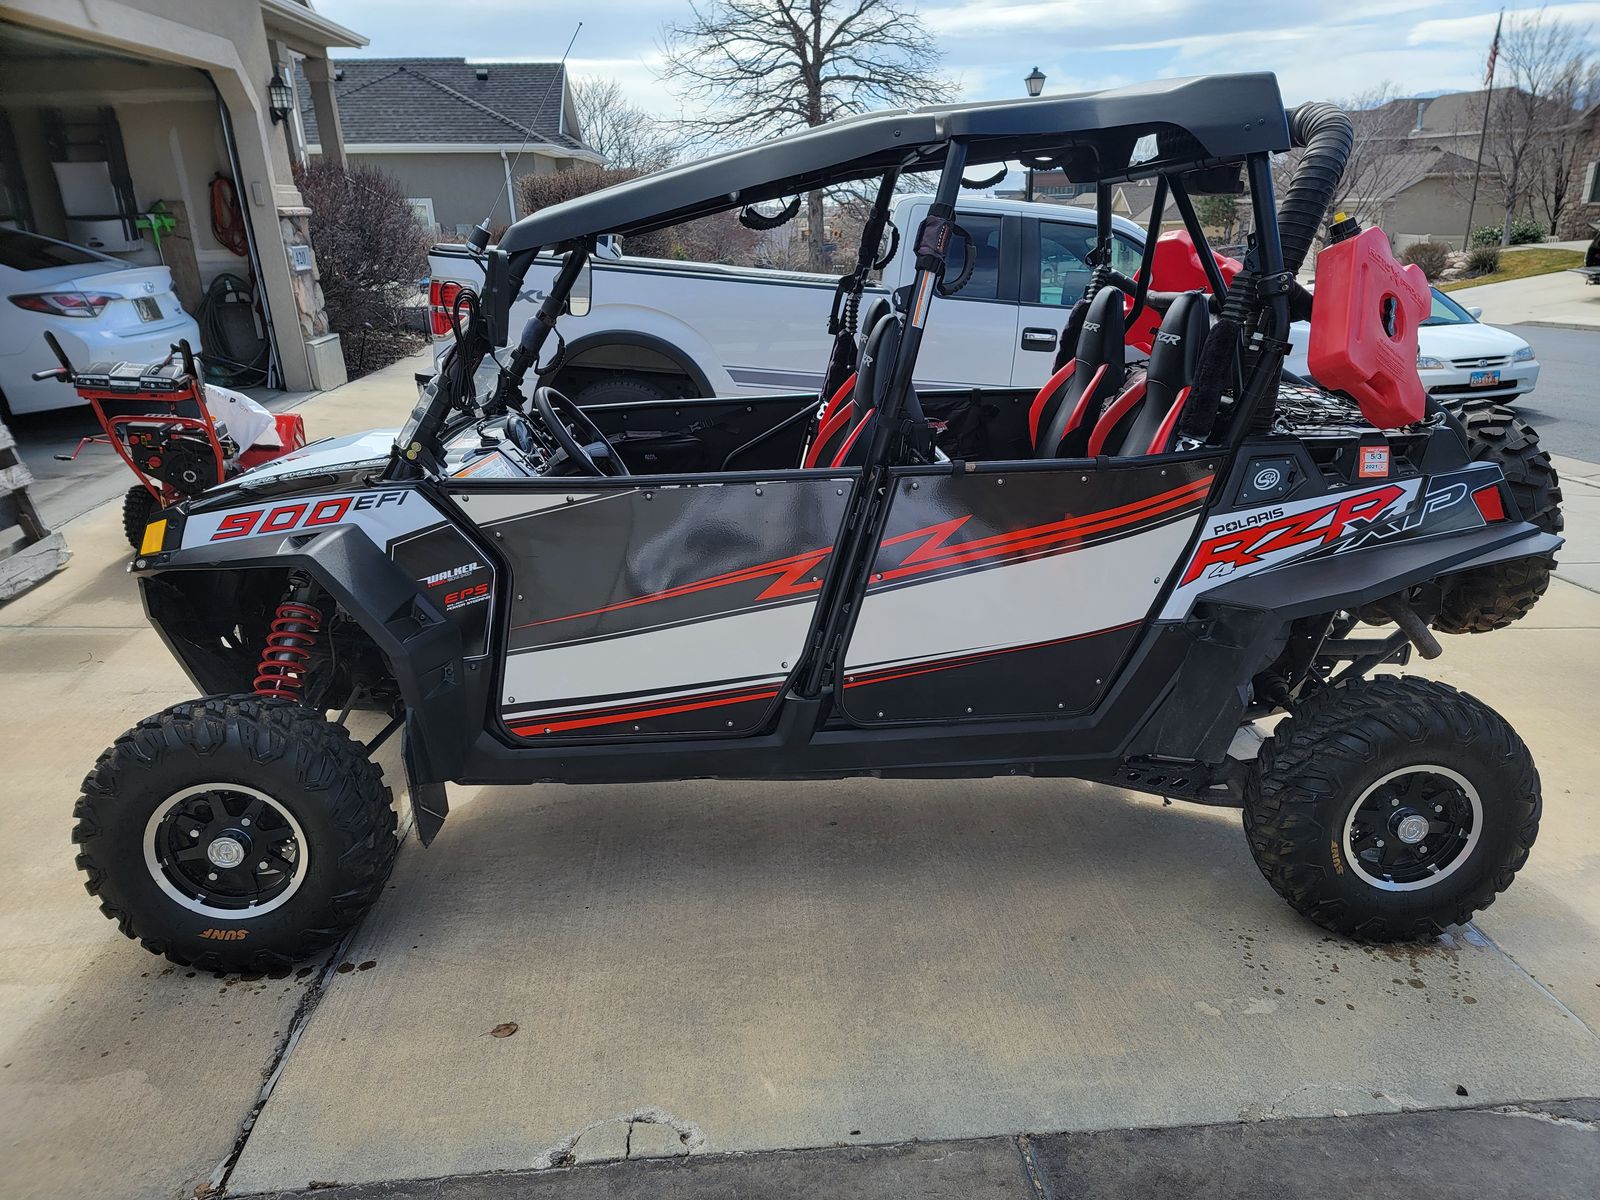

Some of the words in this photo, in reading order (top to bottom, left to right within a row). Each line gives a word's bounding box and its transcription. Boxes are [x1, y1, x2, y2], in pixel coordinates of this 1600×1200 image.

[210, 497, 352, 541] 900
[353, 490, 410, 511] EFI
[1214, 507, 1284, 536] POLARIS
[1177, 484, 1407, 589] RZR
[420, 561, 482, 584] WALKER
[1208, 560, 1237, 579] 4
[444, 583, 488, 605] EPS
[197, 928, 249, 940] SUNF
